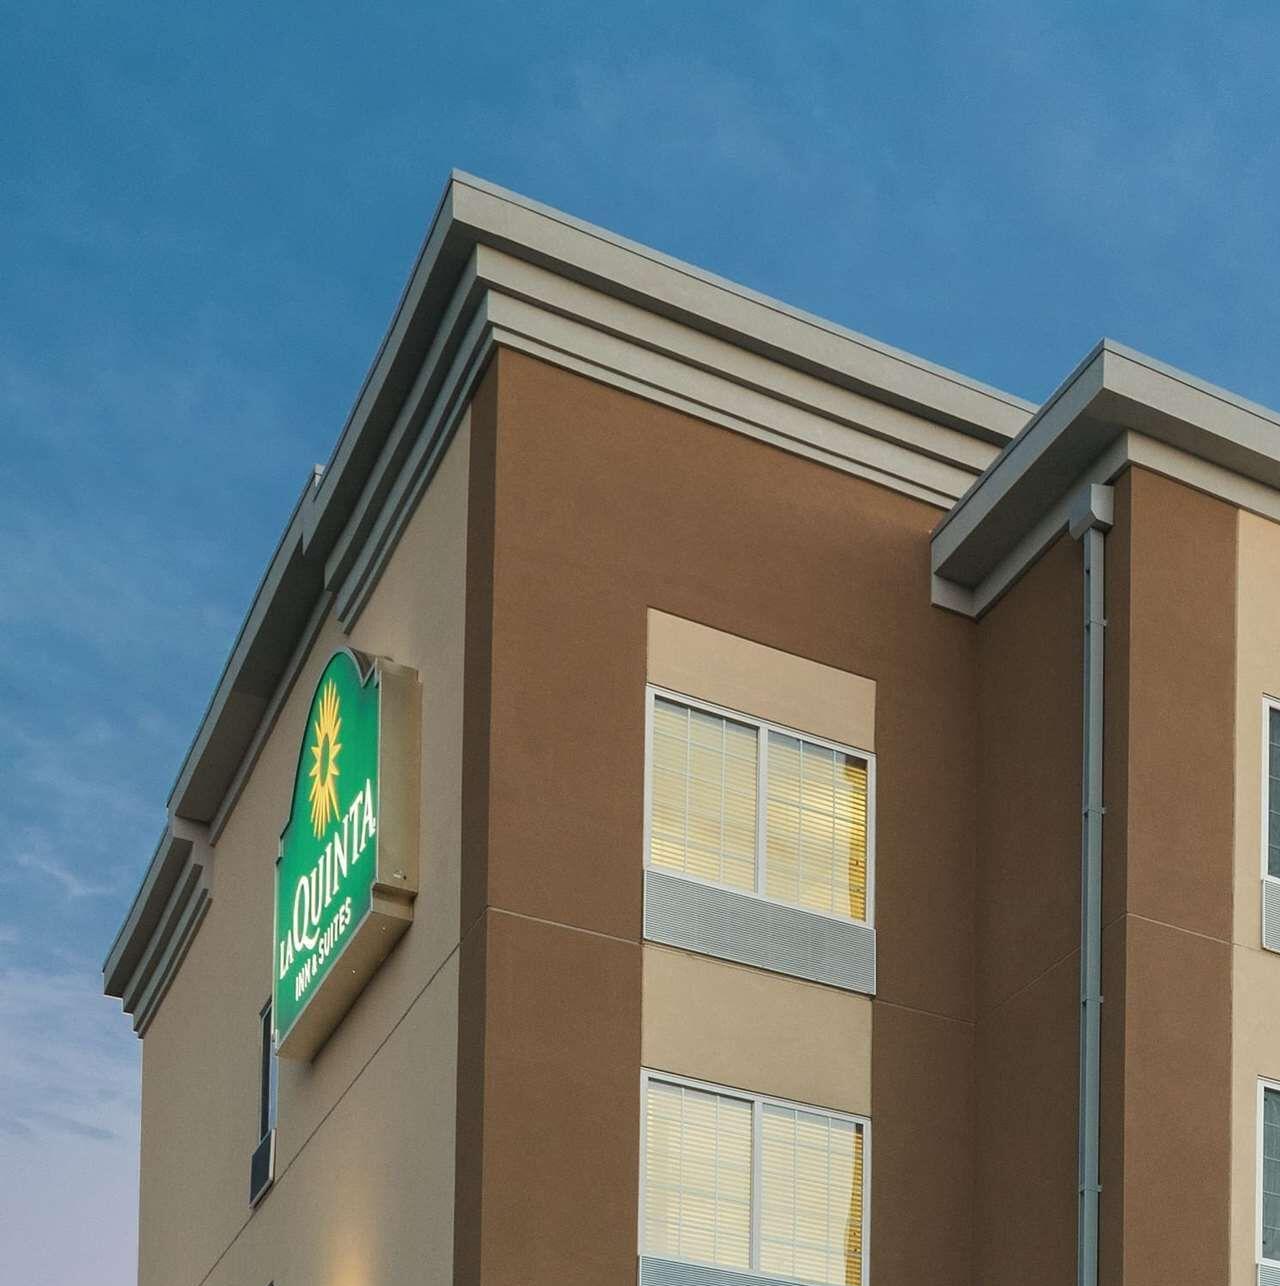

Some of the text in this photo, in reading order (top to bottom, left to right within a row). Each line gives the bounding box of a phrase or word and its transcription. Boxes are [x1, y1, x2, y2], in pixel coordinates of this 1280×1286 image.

[280, 778, 377, 980] LA QUINTA
[295, 958, 311, 1002] INN
[318, 896, 352, 966] SUITES
